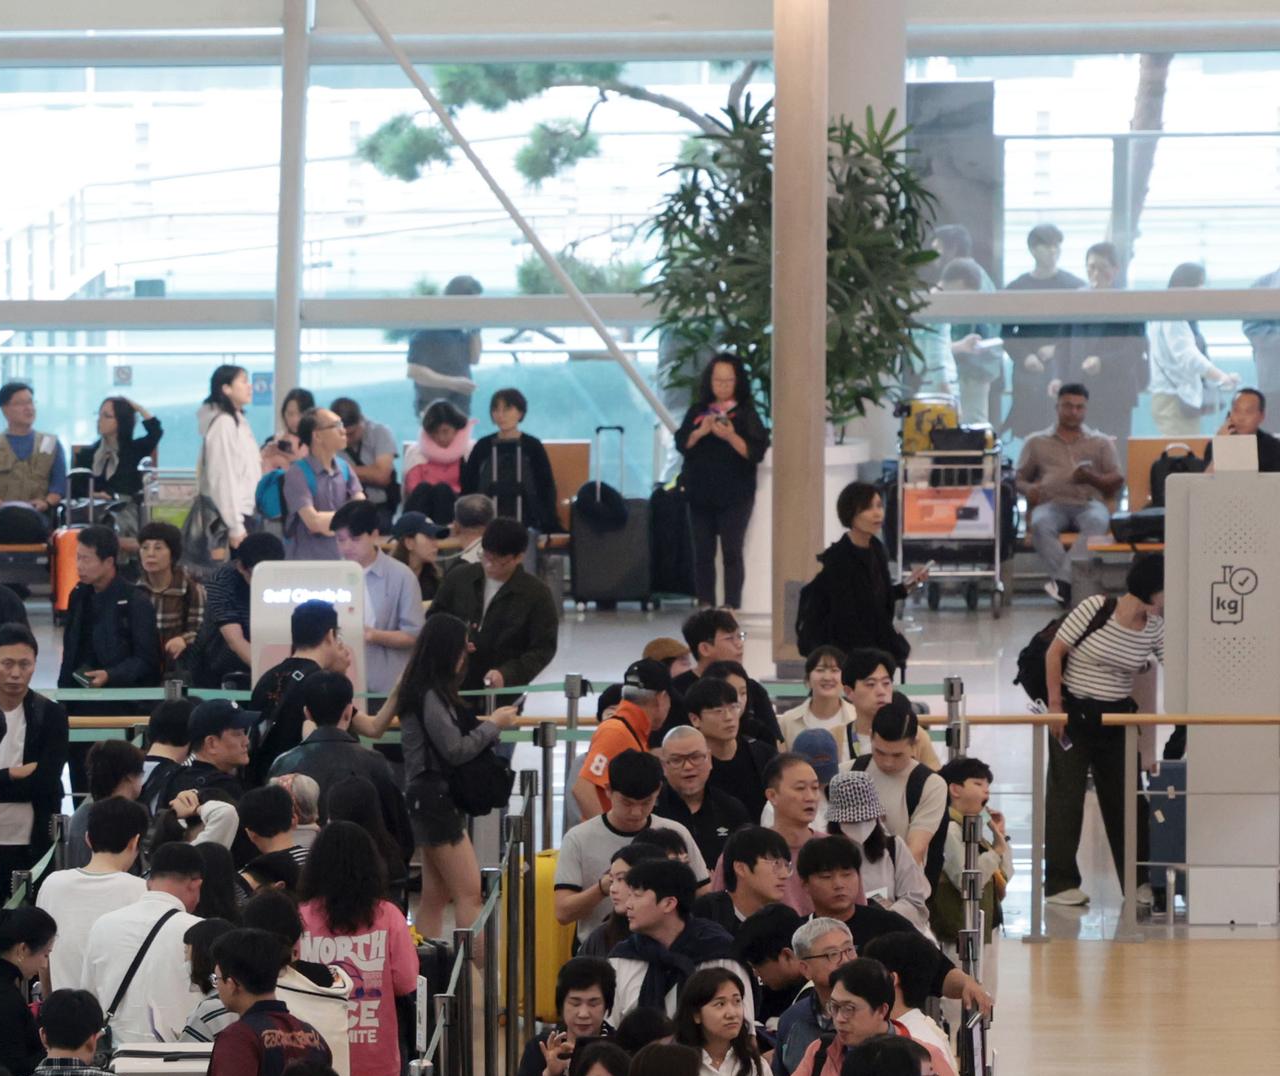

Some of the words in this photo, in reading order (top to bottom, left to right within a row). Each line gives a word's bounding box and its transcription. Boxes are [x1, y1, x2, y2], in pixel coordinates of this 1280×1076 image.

[1216, 597, 1240, 614] kg
[589, 753, 608, 777] 8
[300, 930, 387, 971] NORTH
